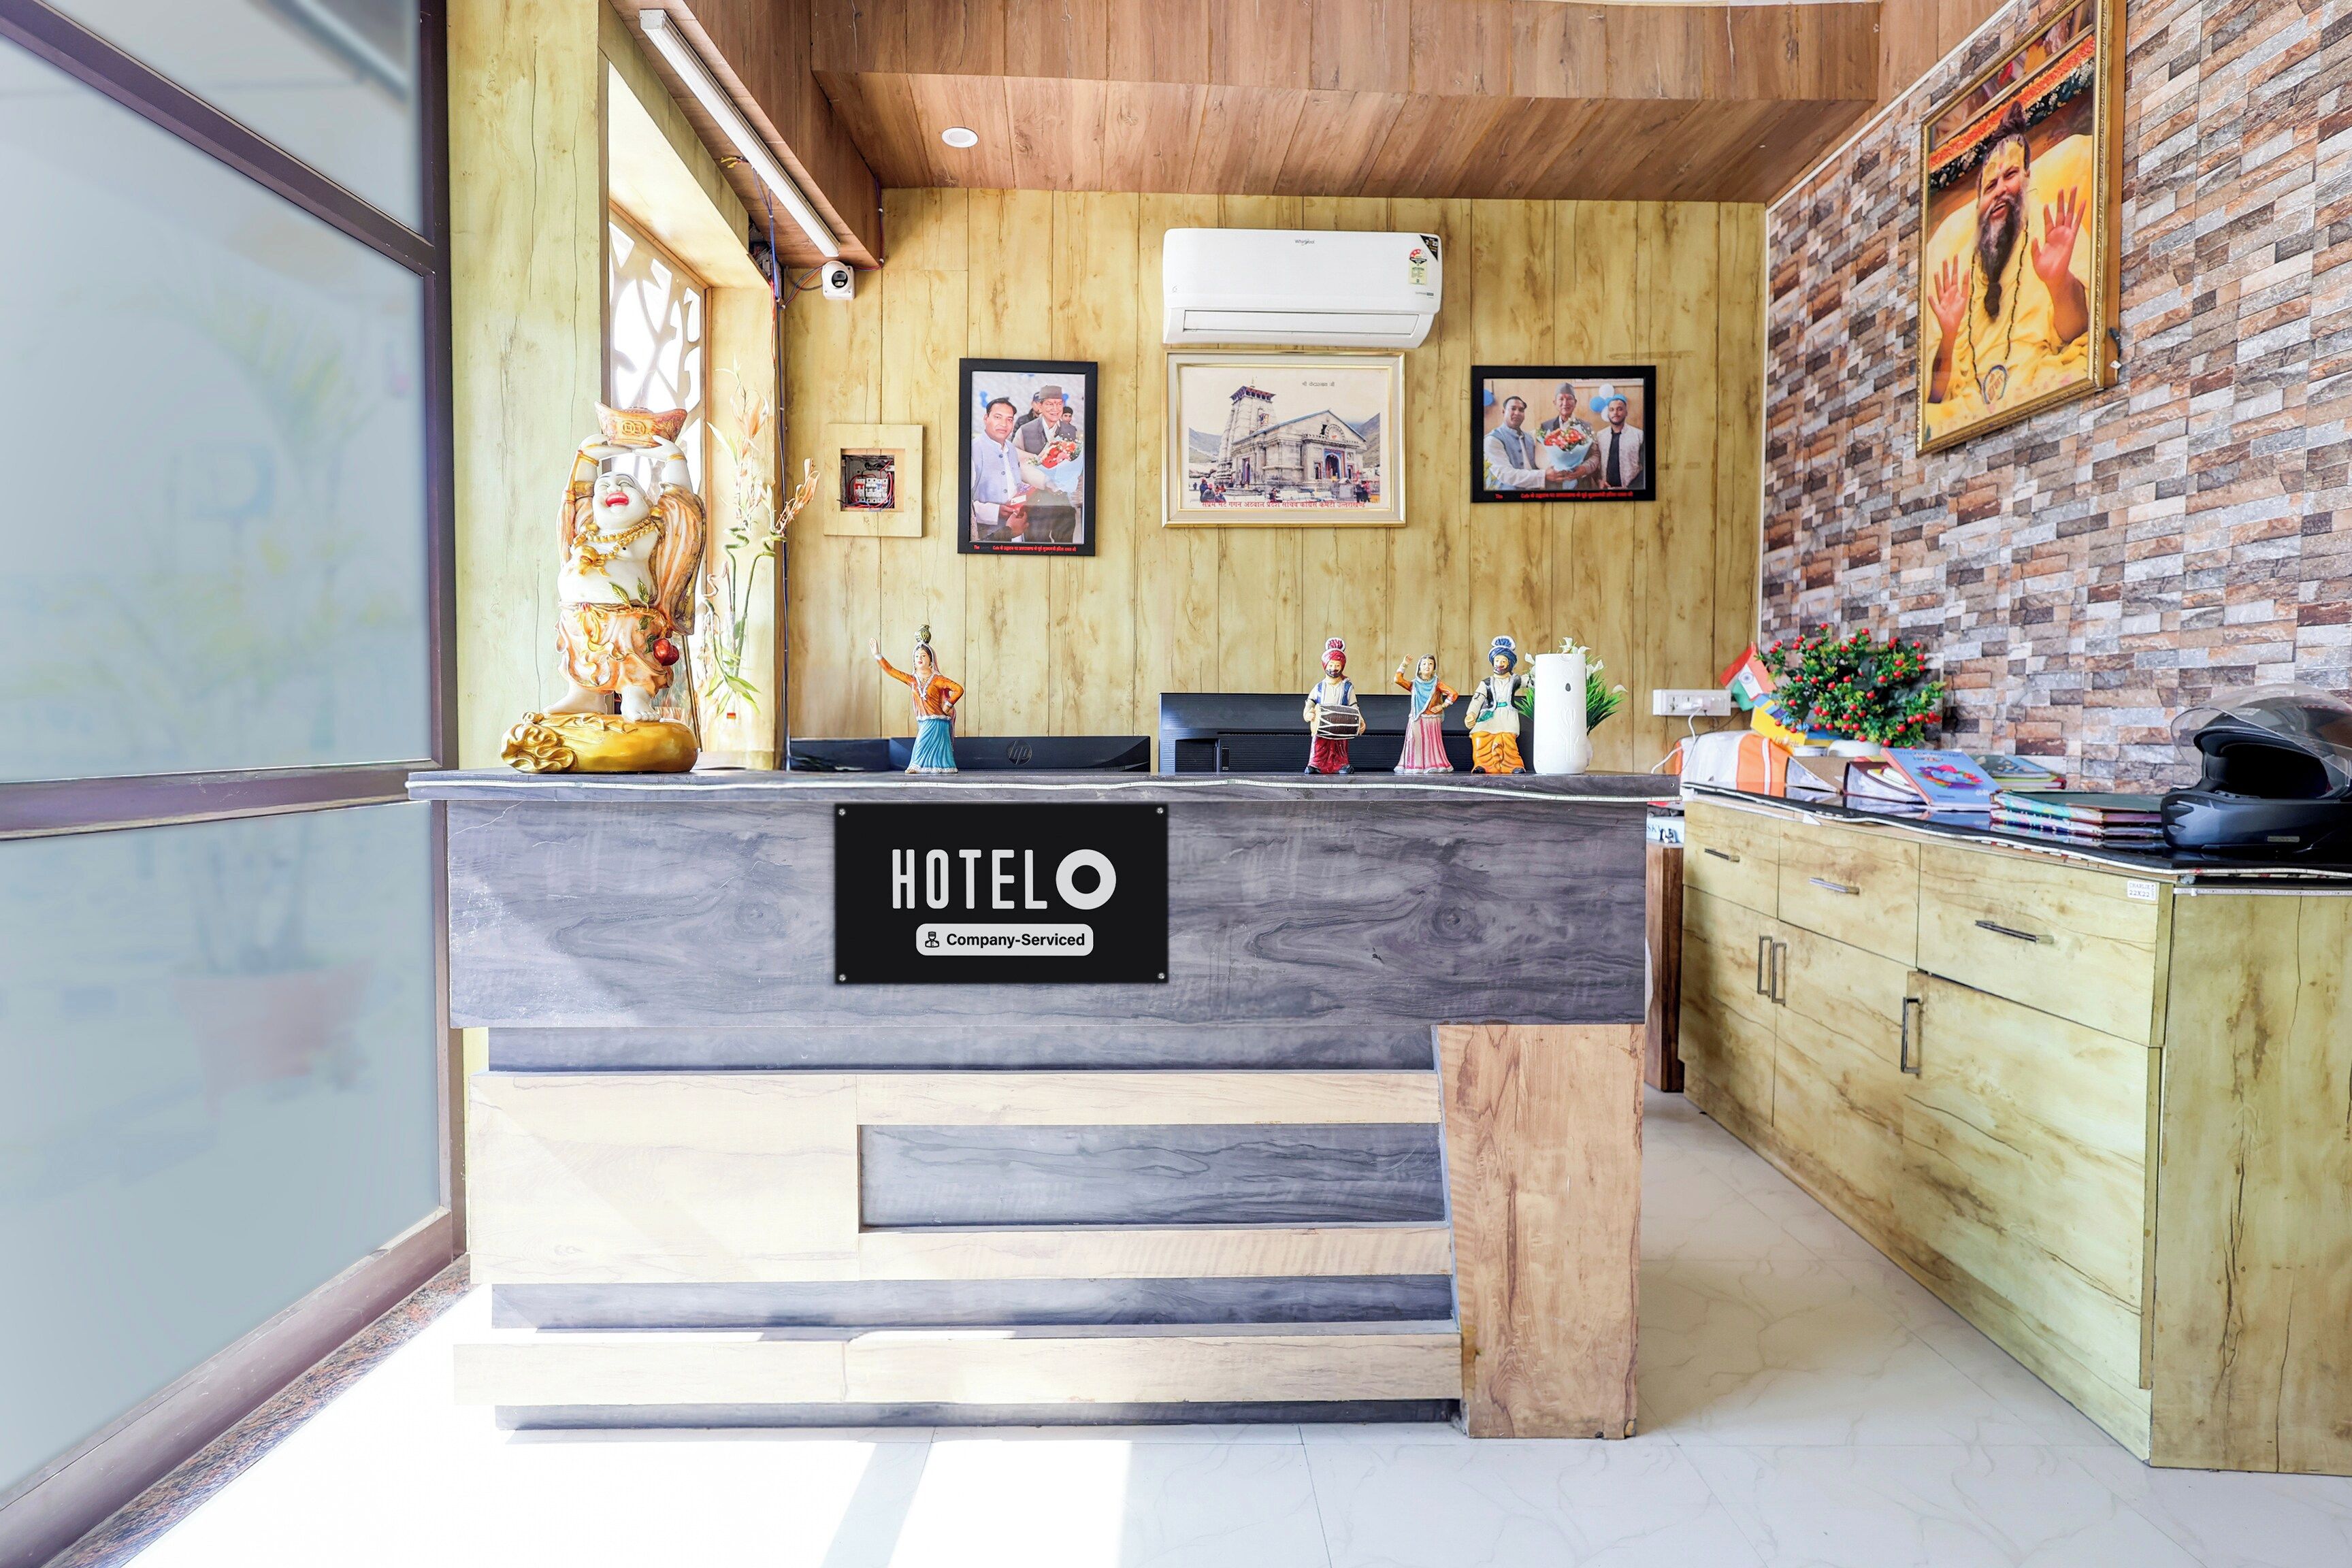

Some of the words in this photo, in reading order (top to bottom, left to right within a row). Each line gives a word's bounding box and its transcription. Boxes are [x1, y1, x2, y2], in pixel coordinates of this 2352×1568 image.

[892, 849, 1047, 909] HOTEL
[1056, 849, 1117, 910] O
[946, 932, 1085, 949] Company-Serviced
